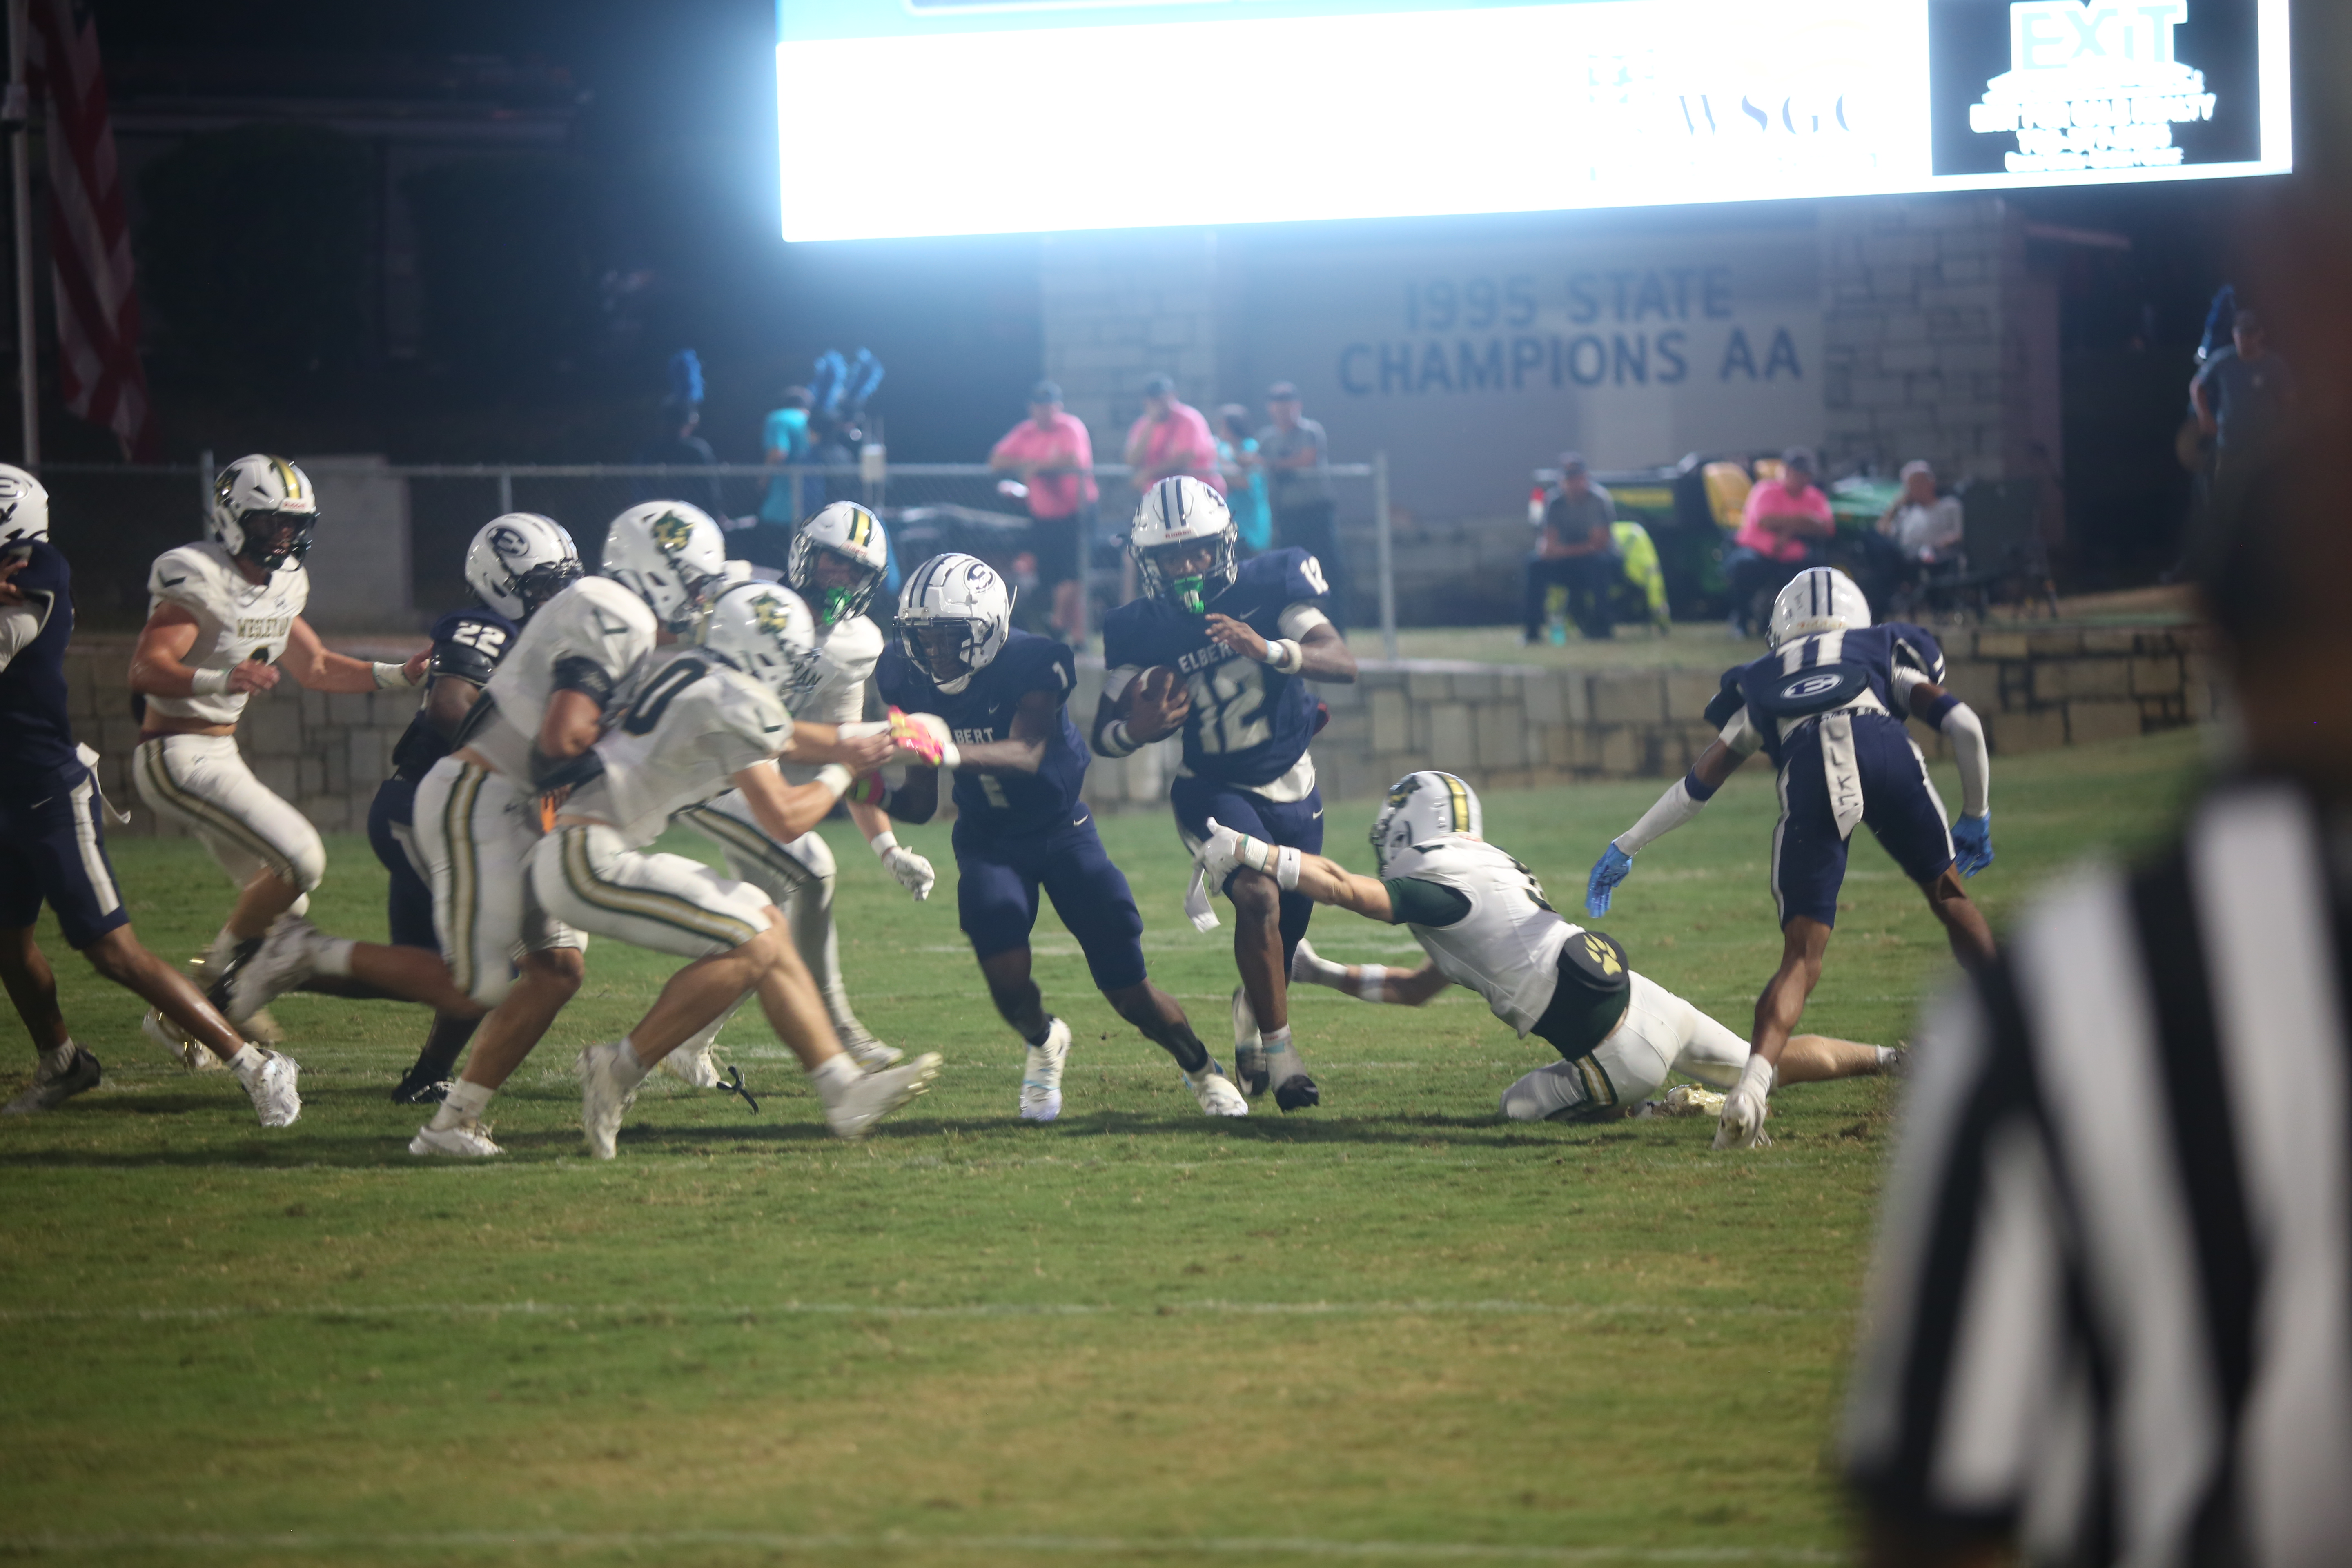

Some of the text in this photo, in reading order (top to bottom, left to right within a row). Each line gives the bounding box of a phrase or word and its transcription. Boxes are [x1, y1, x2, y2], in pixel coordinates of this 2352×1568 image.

[1405, 266, 1731, 332] 1995 STATE
[1338, 325, 1803, 396] CHAMPIONS AA
[1299, 555, 1330, 595] 12
[451, 620, 507, 659] 22
[1178, 641, 1234, 674] ELBER
[1775, 629, 1846, 679] 11
[1051, 660, 1068, 690] 1
[1186, 654, 1273, 753] 12
[953, 726, 994, 745] BERT
